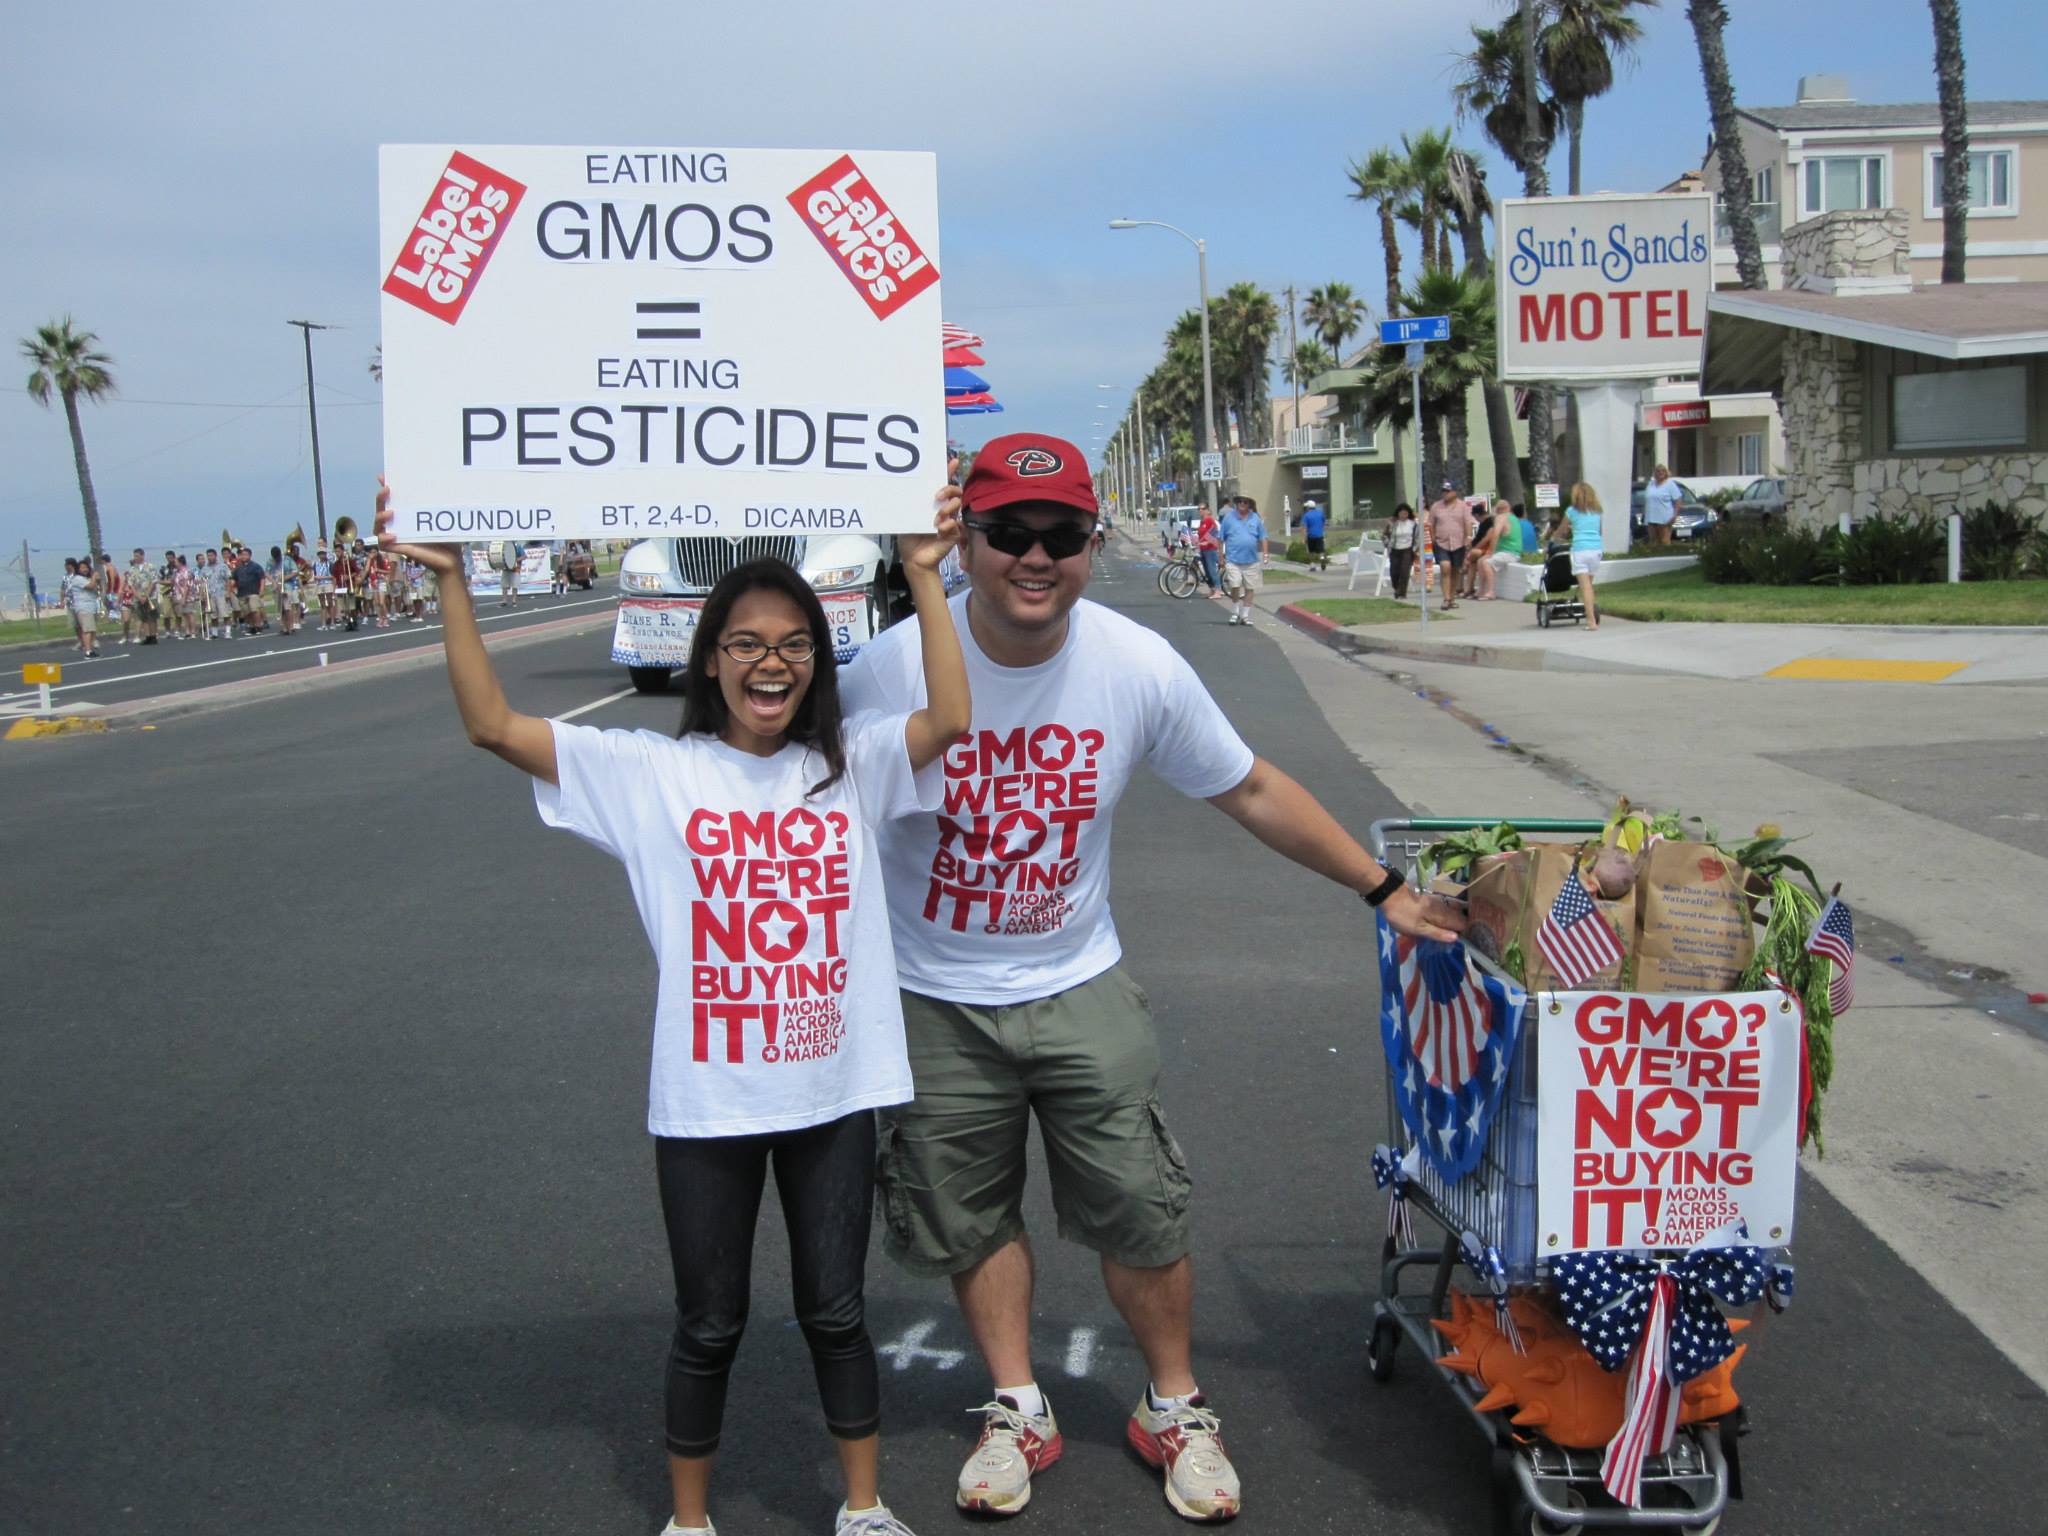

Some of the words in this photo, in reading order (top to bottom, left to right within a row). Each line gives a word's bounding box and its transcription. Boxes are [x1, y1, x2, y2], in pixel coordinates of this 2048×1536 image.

[587, 153, 727, 184] EATING
[393, 168, 479, 289] Label
[537, 200, 774, 264] GMOS
[830, 169, 929, 282] Label
[1601, 219, 1708, 282] Sands
[1519, 289, 1704, 343] MOTEL
[597, 358, 740, 389] EATING
[462, 404, 921, 474] PESTICIDES
[1203, 466, 1221, 478] 45
[416, 508, 555, 532] ROUNDUP,
[602, 506, 638, 528] BT,
[744, 508, 864, 528] DICAMBA
[943, 724, 1105, 779] GMO?
[944, 771, 1098, 816] WE'RE
[685, 807, 849, 858] GMO?
[936, 808, 1096, 862] NOT
[690, 853, 850, 899] WE'RE
[932, 848, 1080, 891] BUYING
[922, 876, 1006, 934] IT!
[1007, 902, 1075, 927] AMERICA
[1009, 890, 1063, 905] MOMS
[691, 896, 850, 963] NOT
[1004, 917, 1063, 935] MARCH
[692, 958, 848, 1001] BUYING
[783, 997, 836, 1016] MOMS
[784, 1010, 842, 1032] ACROSS
[1575, 995, 1767, 1050] GMO?
[692, 1002, 781, 1064] IT!
[784, 1023, 847, 1047] AMERICA
[784, 1040, 838, 1063] MARCH
[1578, 1047, 1760, 1088] WE'RE
[1575, 1088, 1759, 1149] NOT
[1574, 1151, 1754, 1187] BUYING
[1665, 1201, 1739, 1216] ACROSS
[1666, 1187, 1728, 1201] MOMS
[1572, 1188, 1662, 1249] IT!
[1663, 1231, 1706, 1246] MAR
